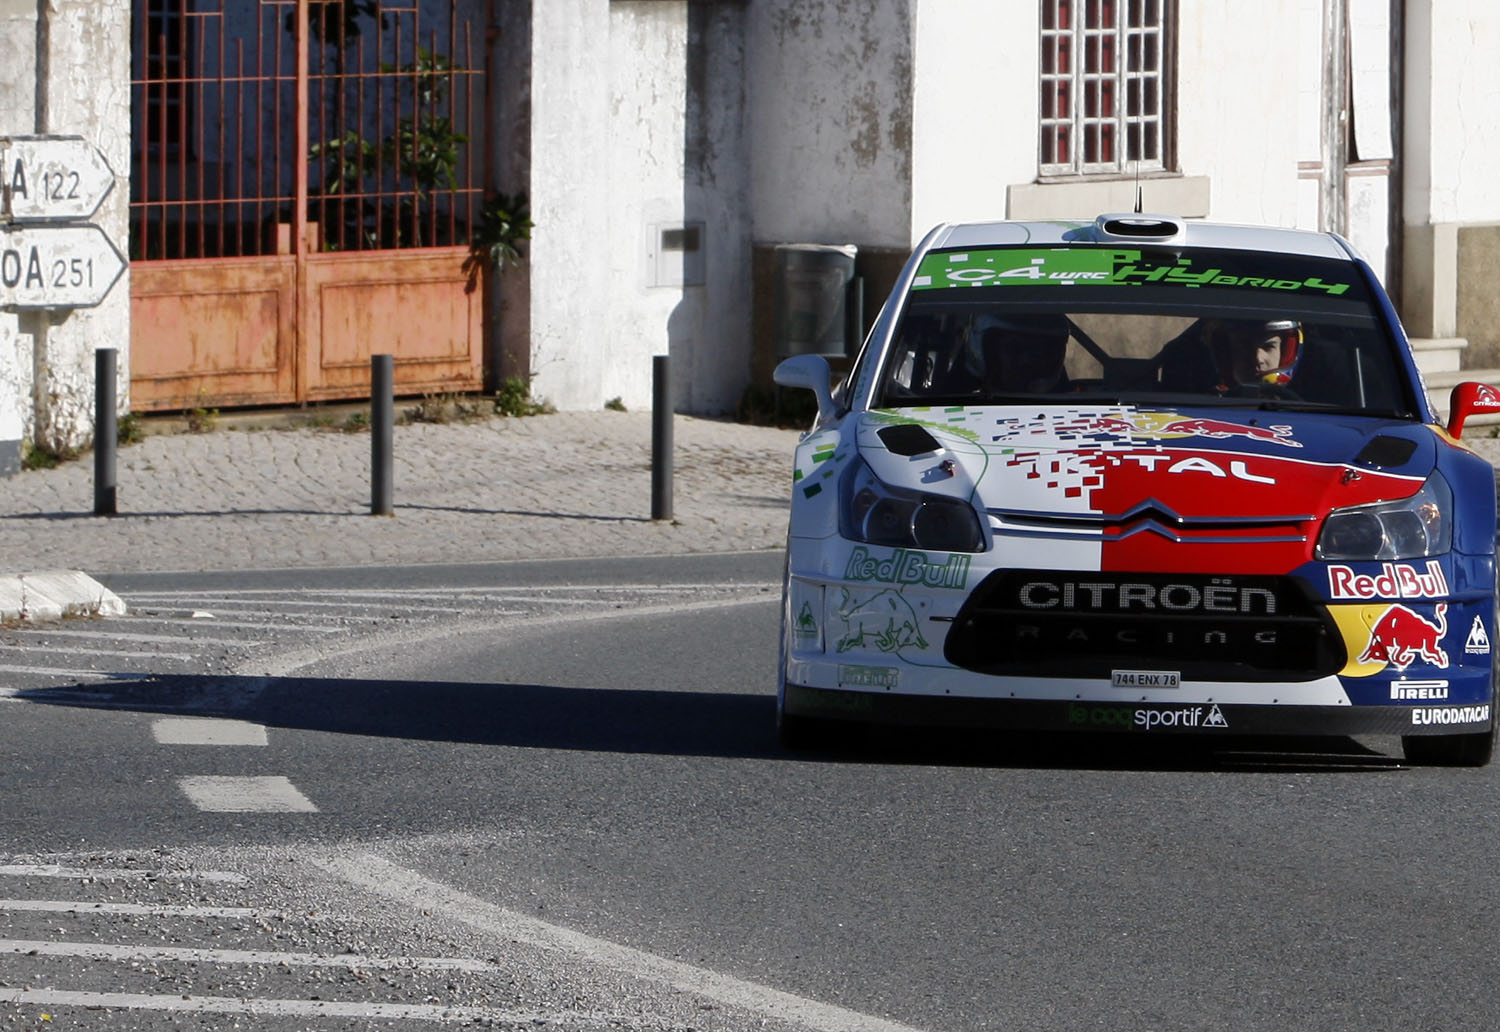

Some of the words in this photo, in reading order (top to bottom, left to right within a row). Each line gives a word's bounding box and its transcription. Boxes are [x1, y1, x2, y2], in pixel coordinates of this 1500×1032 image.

[43, 171, 80, 200] 122
[53, 258, 93, 288] 251
[945, 265, 1046, 281] C4
[1049, 271, 1109, 279] WRC
[844, 546, 901, 581] Red
[896, 551, 971, 590] Bull
[1328, 563, 1400, 599] Red
[1396, 560, 1449, 599] Bull
[1115, 673, 1135, 685] 744
[1138, 674, 1159, 685] ENX
[1163, 675, 1176, 686] 78
[1390, 679, 1449, 699] PIRELLI
[1134, 707, 1202, 730] sportif
